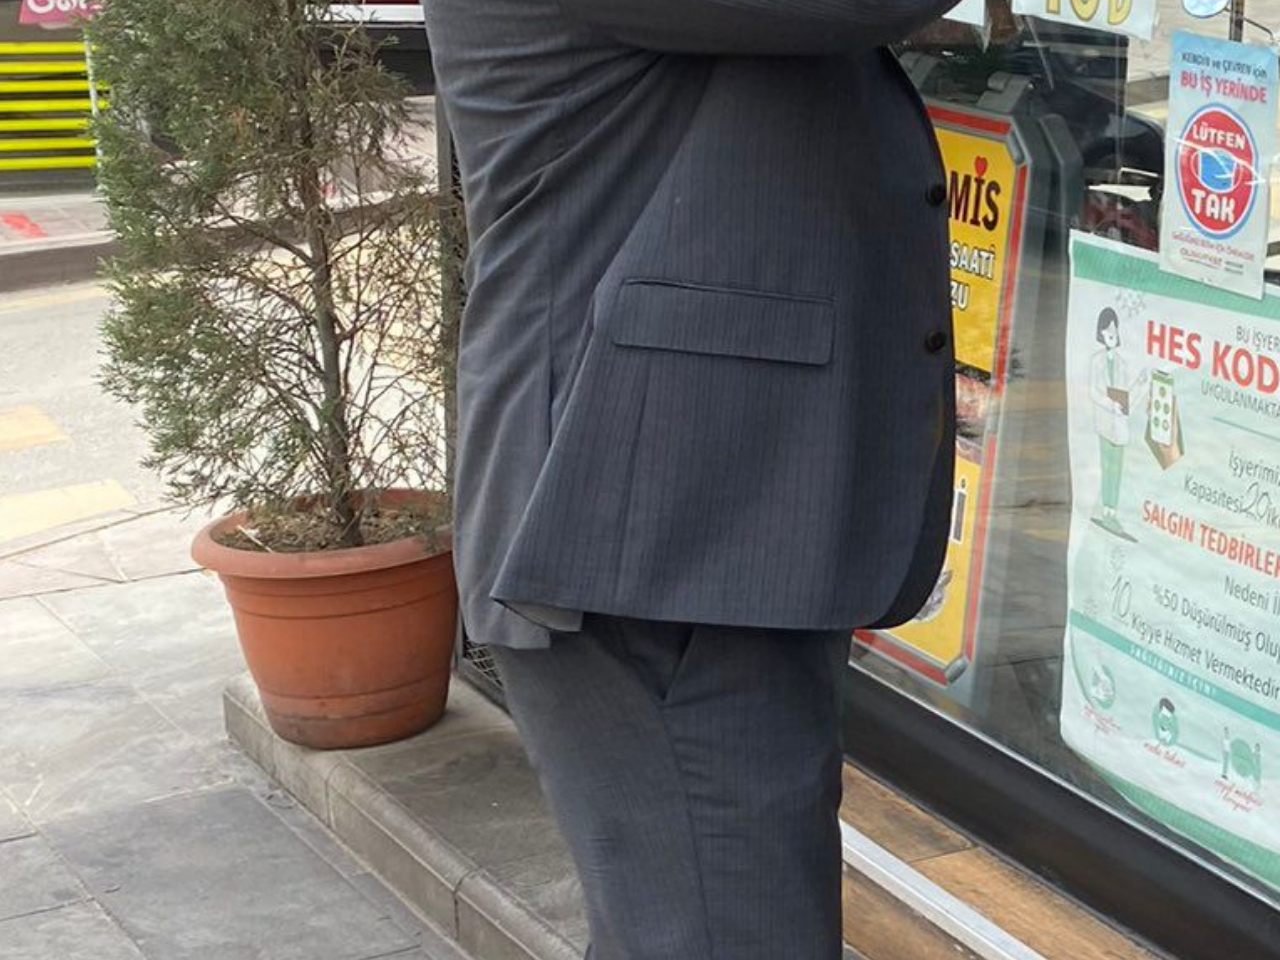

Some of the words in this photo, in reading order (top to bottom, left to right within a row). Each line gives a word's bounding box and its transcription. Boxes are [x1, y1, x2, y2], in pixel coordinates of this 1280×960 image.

[1181, 70, 1197, 89] BU
[1200, 70, 1212, 98] İŞ
[1215, 77, 1267, 103] YERİNDE
[1192, 121, 1245, 150] LÜTFEN
[1191, 188, 1235, 223] TAK
[1146, 320, 1202, 369] HES
[1236, 325, 1250, 344] BU
[1142, 499, 1196, 543] SALGIN
[1152, 583, 1179, 612] %50
[1224, 575, 1269, 612] Nedeni
[1164, 630, 1202, 665] Hizmet
